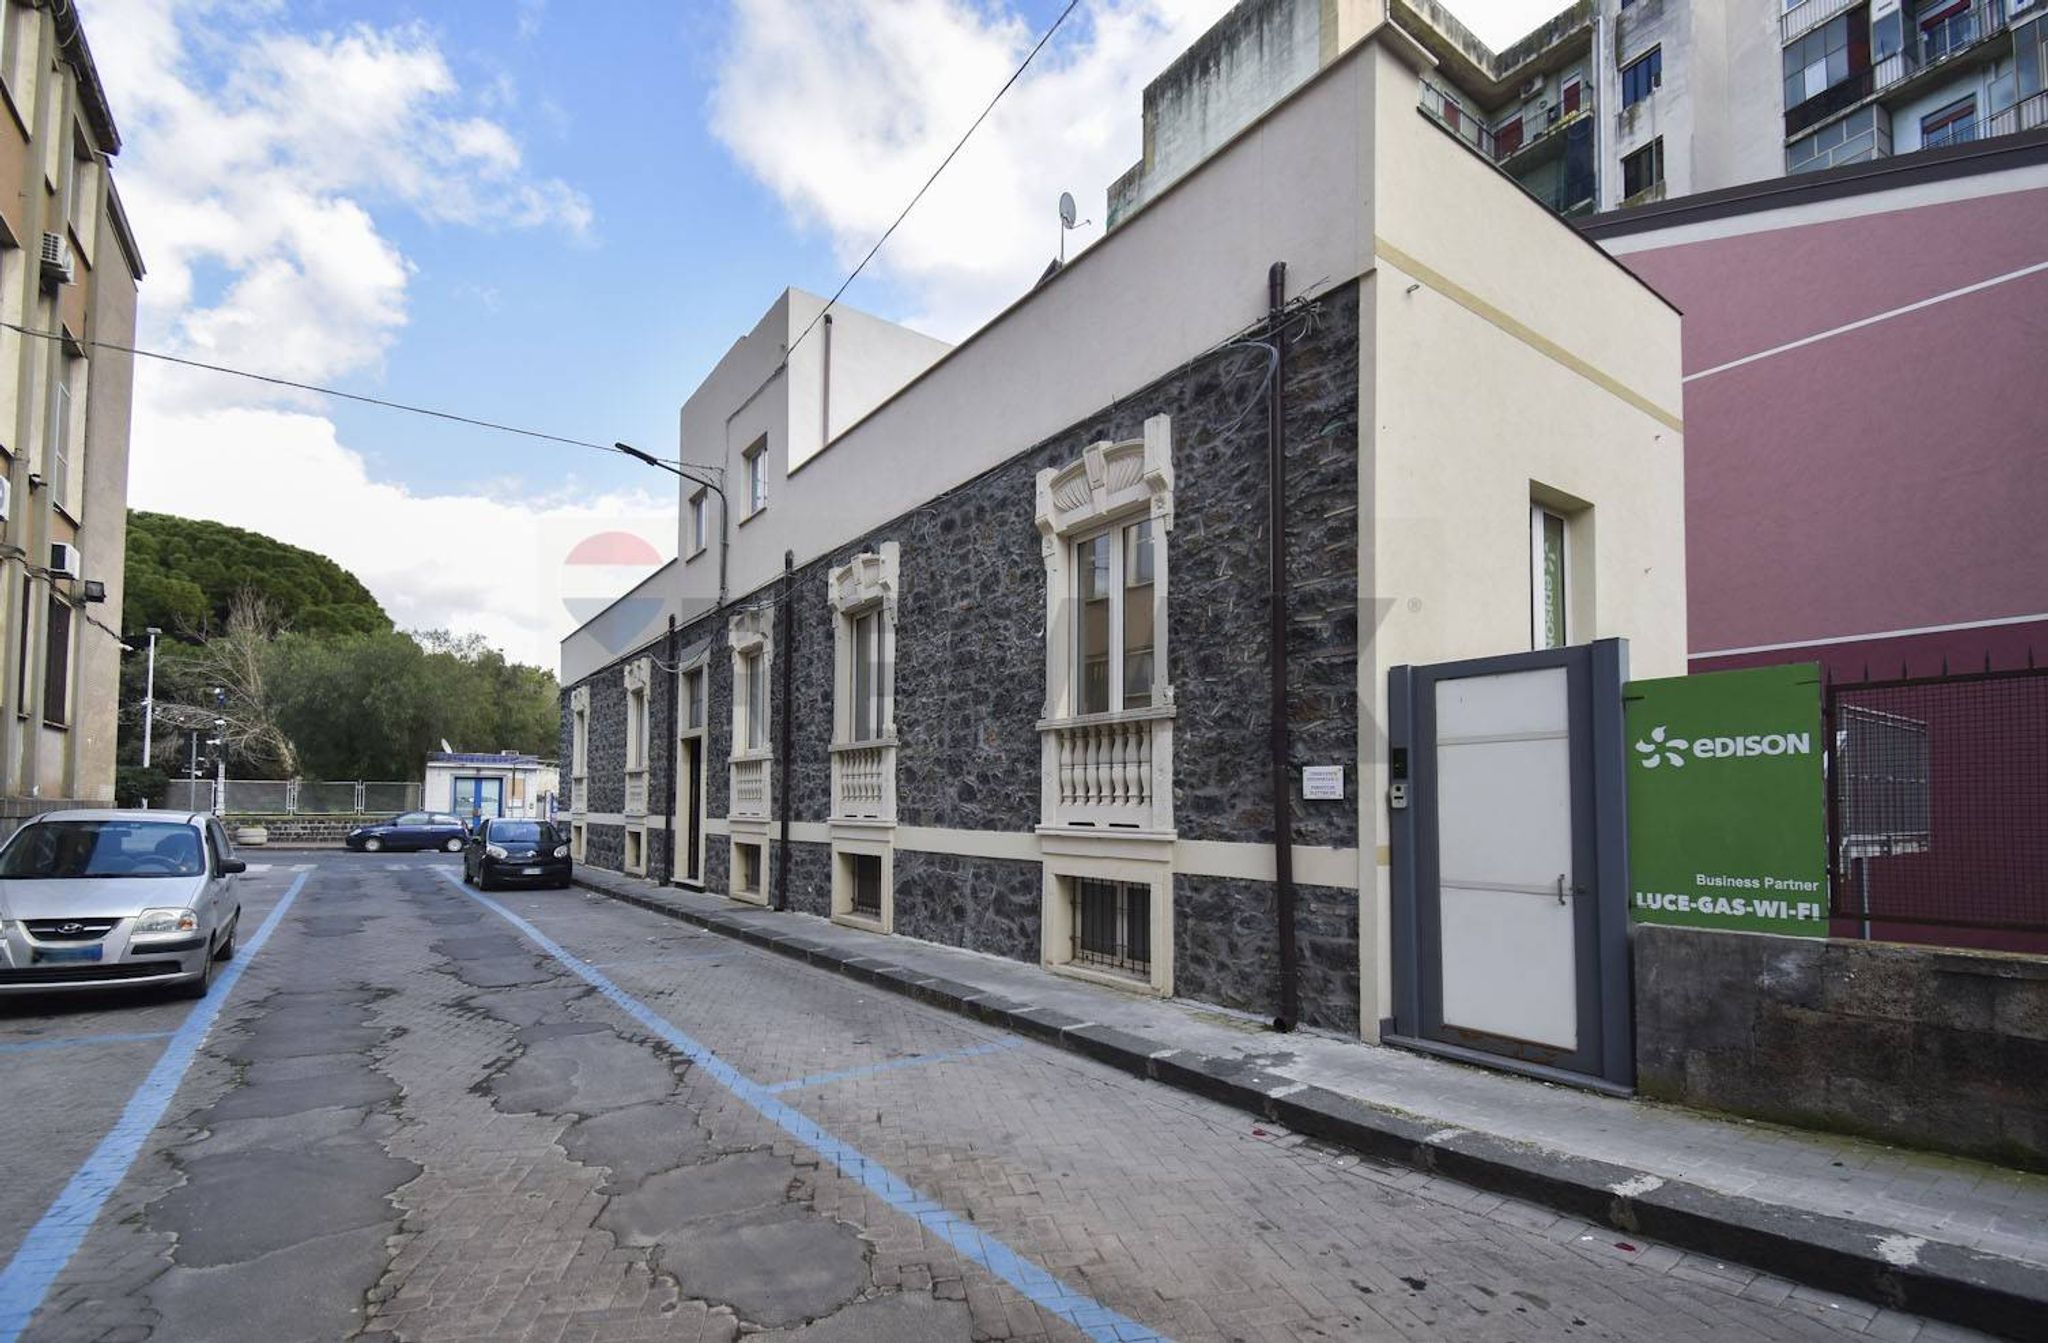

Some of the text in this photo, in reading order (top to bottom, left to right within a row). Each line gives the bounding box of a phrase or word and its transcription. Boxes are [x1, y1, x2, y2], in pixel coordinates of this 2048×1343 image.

[1695, 874, 1819, 891] Business Partner
[1636, 892, 1820, 920] LUCE-GAS-WI-FI
